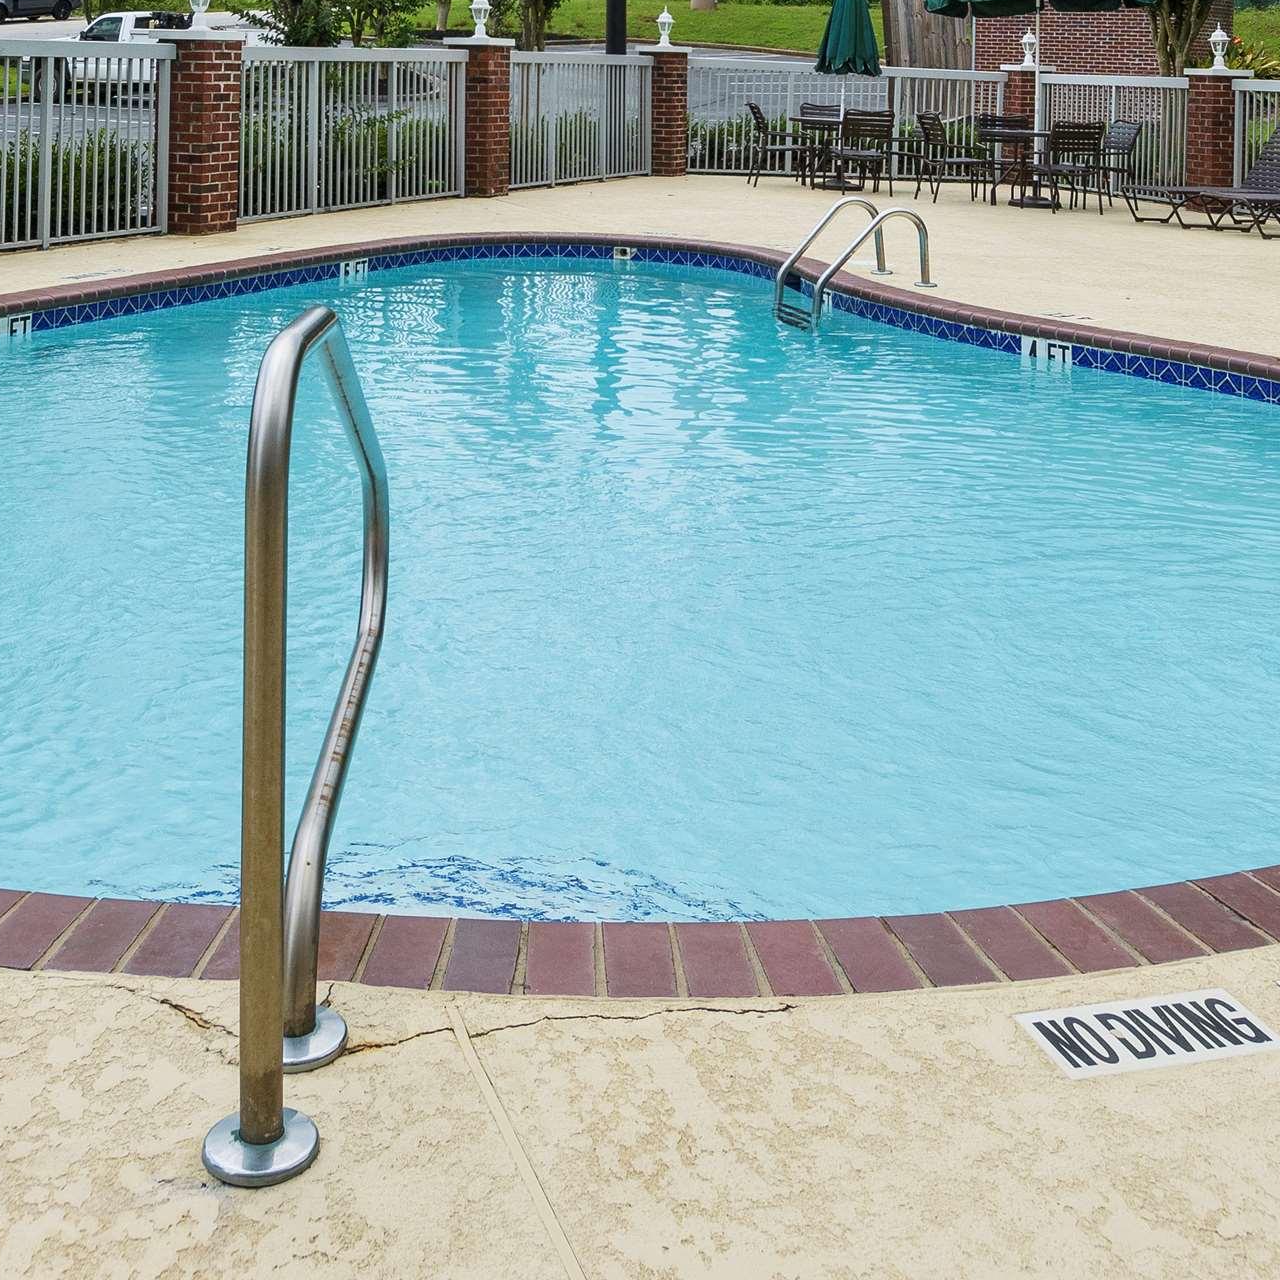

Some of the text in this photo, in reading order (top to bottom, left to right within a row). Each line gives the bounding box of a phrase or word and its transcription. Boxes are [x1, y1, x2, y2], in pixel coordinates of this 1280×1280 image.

[10, 315, 31, 337] FT
[1048, 343, 1070, 363] FT
[1032, 998, 1273, 1068] NO DIVING
